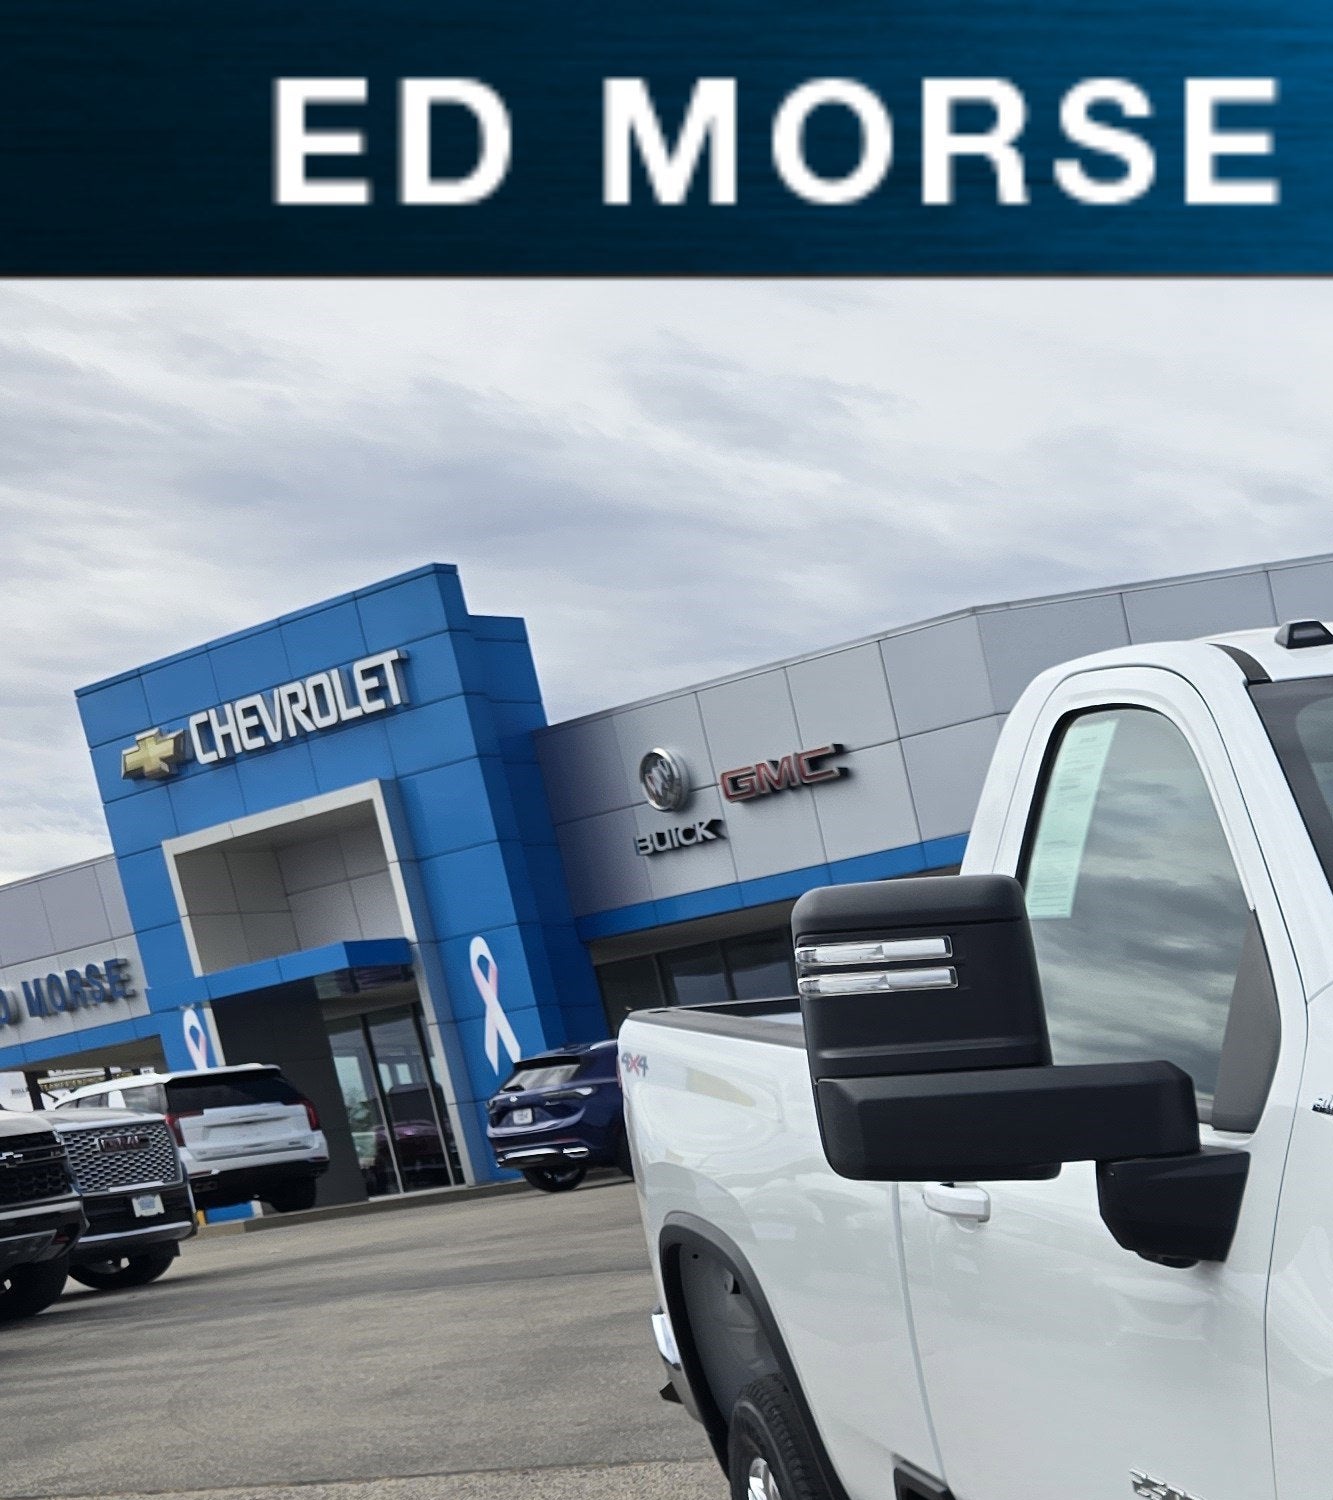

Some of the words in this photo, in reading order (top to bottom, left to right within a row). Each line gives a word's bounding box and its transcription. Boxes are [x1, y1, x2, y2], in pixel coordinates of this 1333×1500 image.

[189, 649, 406, 765] CHEVROLET
[720, 743, 848, 803] GMC
[634, 818, 724, 856] BUICK
[21, 957, 134, 1018] MORSE
